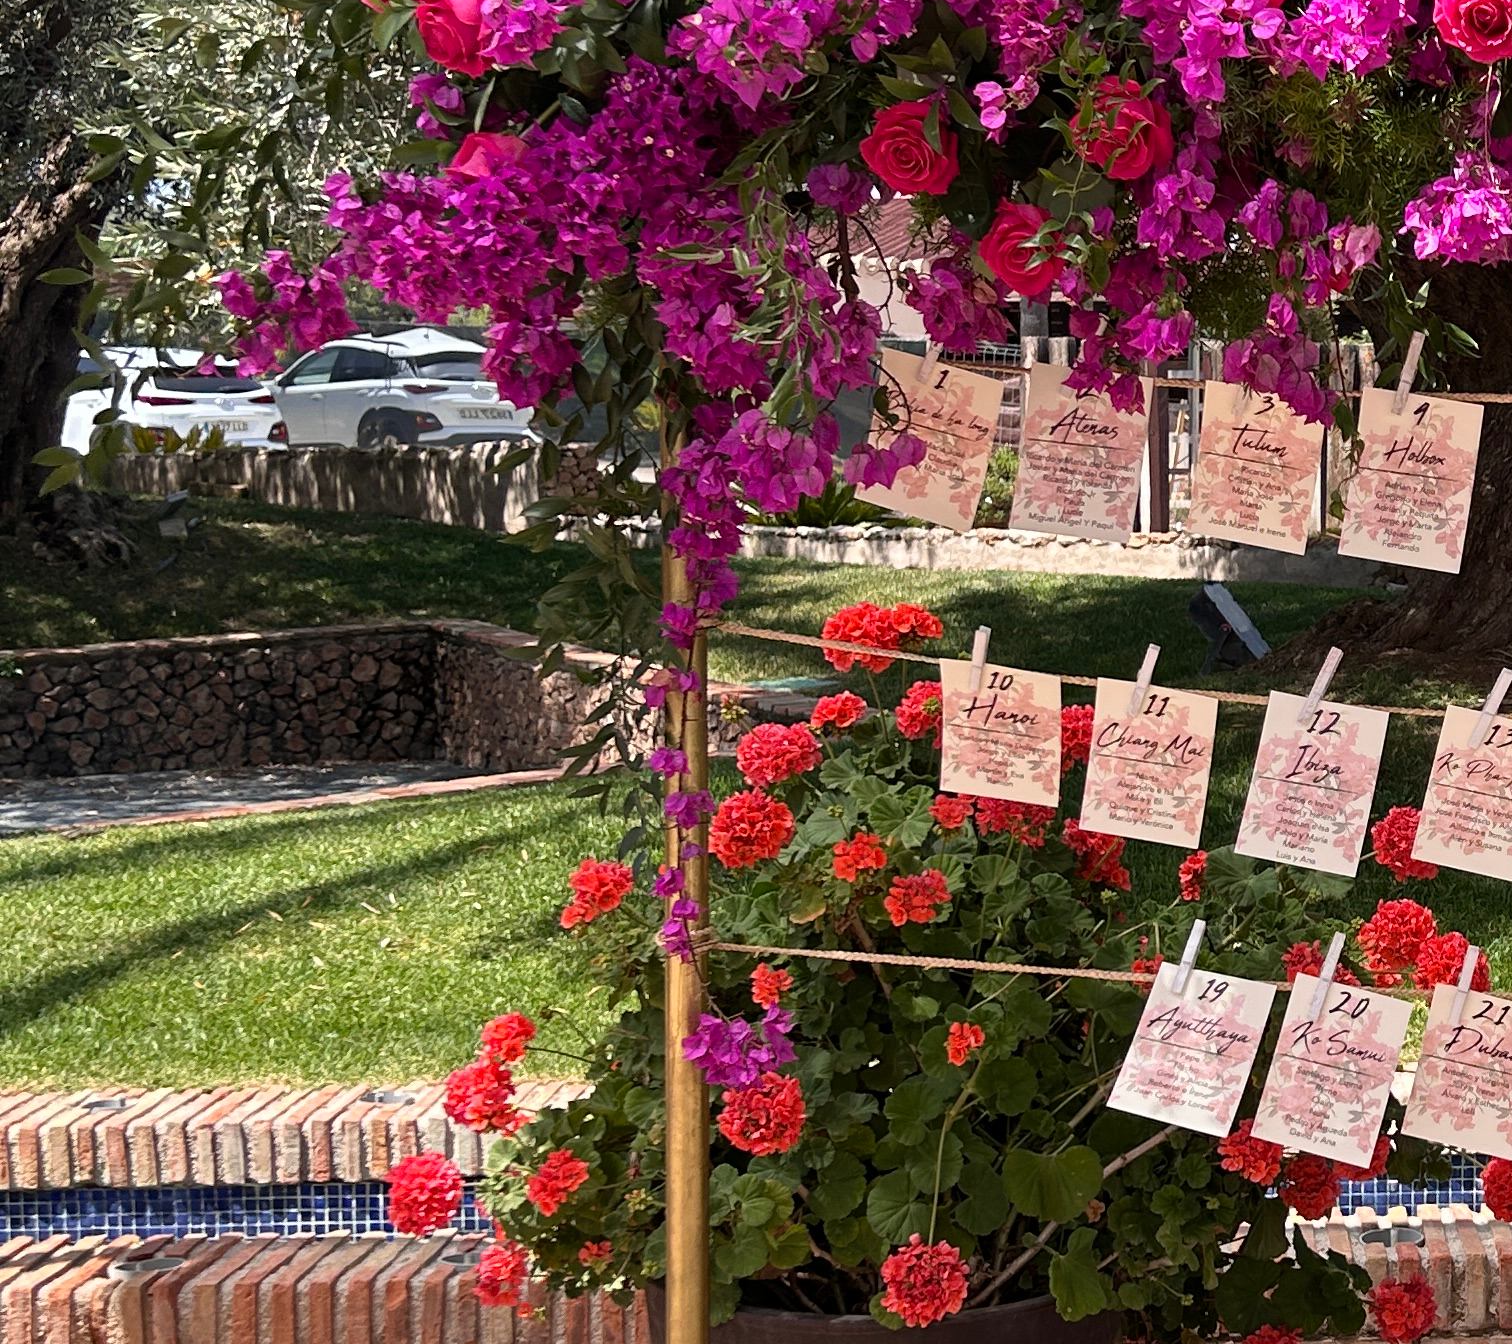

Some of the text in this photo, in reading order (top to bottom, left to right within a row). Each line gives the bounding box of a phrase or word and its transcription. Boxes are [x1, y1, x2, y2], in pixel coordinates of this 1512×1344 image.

[935, 370, 949, 389] 1
[1255, 396, 1275, 415] 3
[1049, 407, 1119, 444] Atenas
[1232, 424, 1288, 458] Tulum
[1384, 436, 1446, 469] Holbox
[1029, 512, 1056, 524] Miguel
[987, 671, 1014, 691] 10
[963, 693, 1040, 727] Hanoi
[1143, 694, 1170, 717] 11
[1306, 709, 1341, 735] 12
[1096, 722, 1206, 764] Chiang Mai
[1285, 744, 1344, 783] Ibiza
[1197, 979, 1229, 1002] 19
[1329, 991, 1370, 1019] 20
[1472, 1000, 1511, 1025] 21
[1290, 1021, 1386, 1062] Ko Samui
